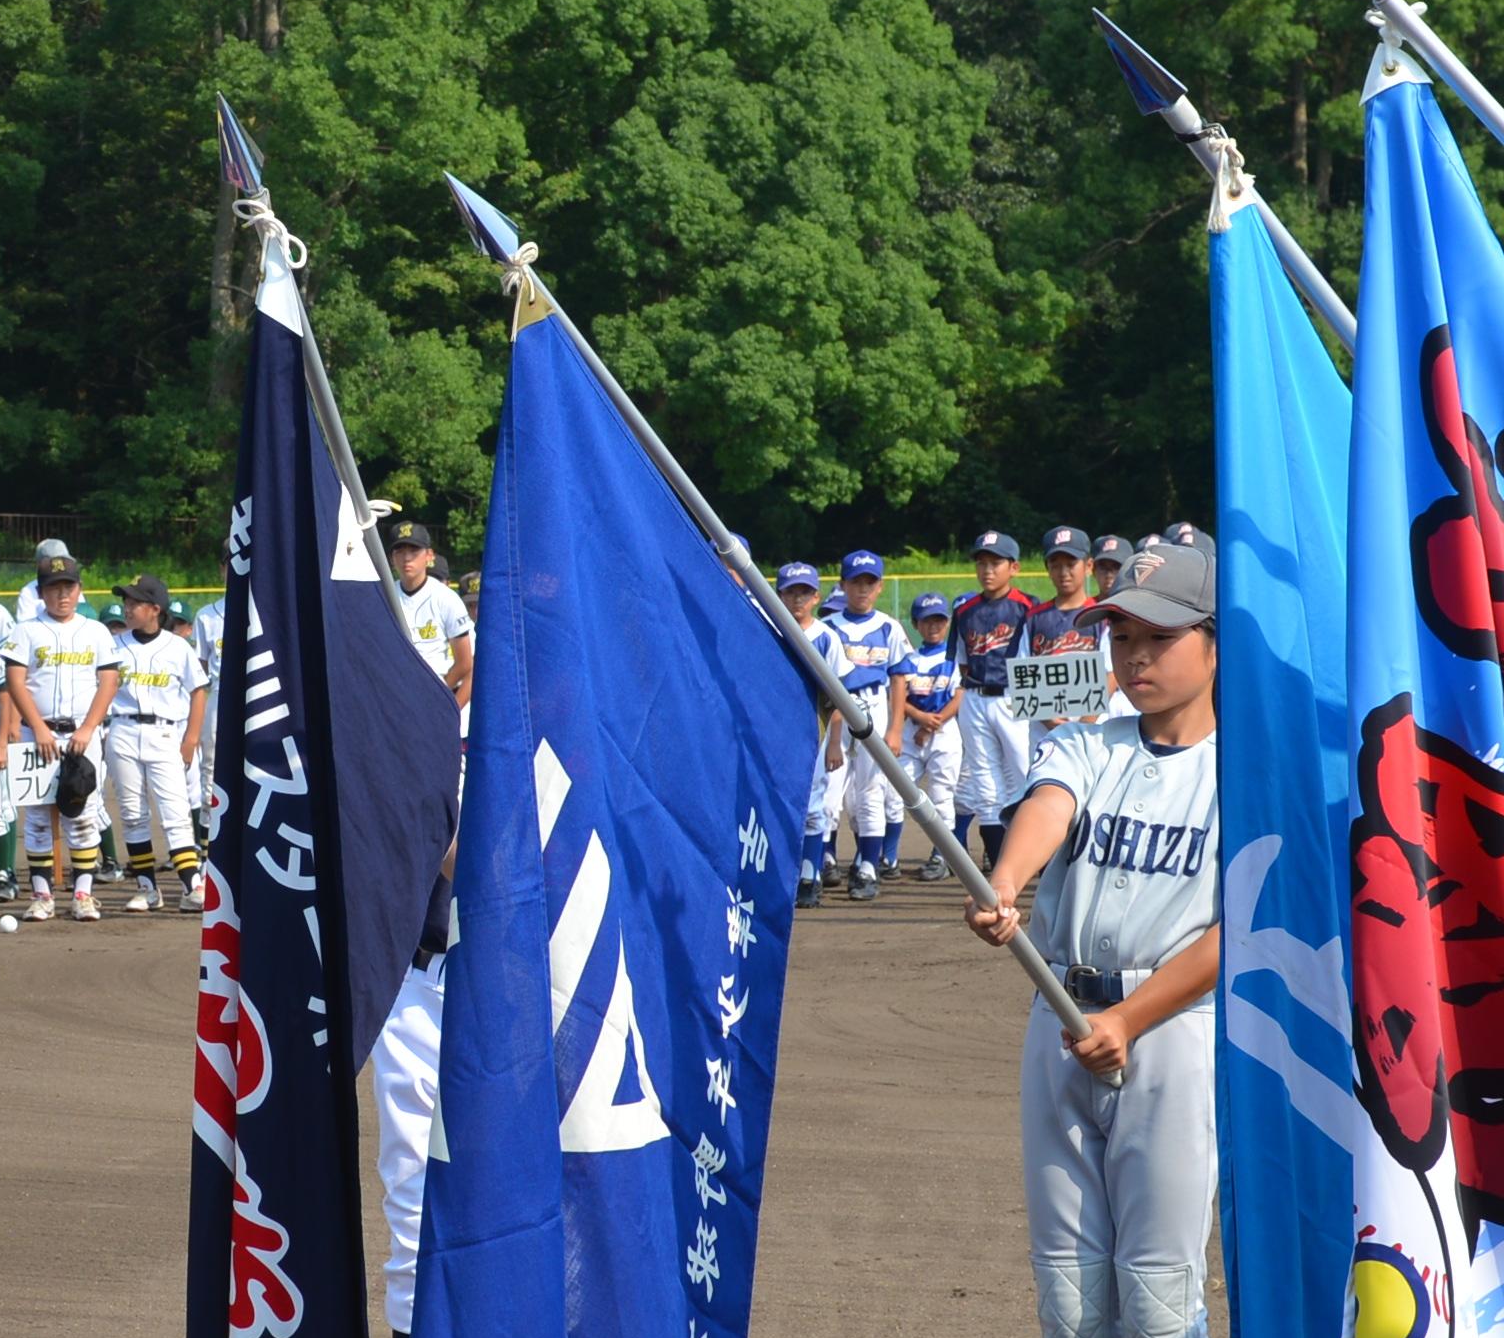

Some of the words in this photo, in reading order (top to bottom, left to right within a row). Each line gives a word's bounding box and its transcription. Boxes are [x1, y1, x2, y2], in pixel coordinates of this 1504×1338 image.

[1013, 658, 1100, 690] 野田川
[1013, 686, 1107, 719] スターボーイズ
